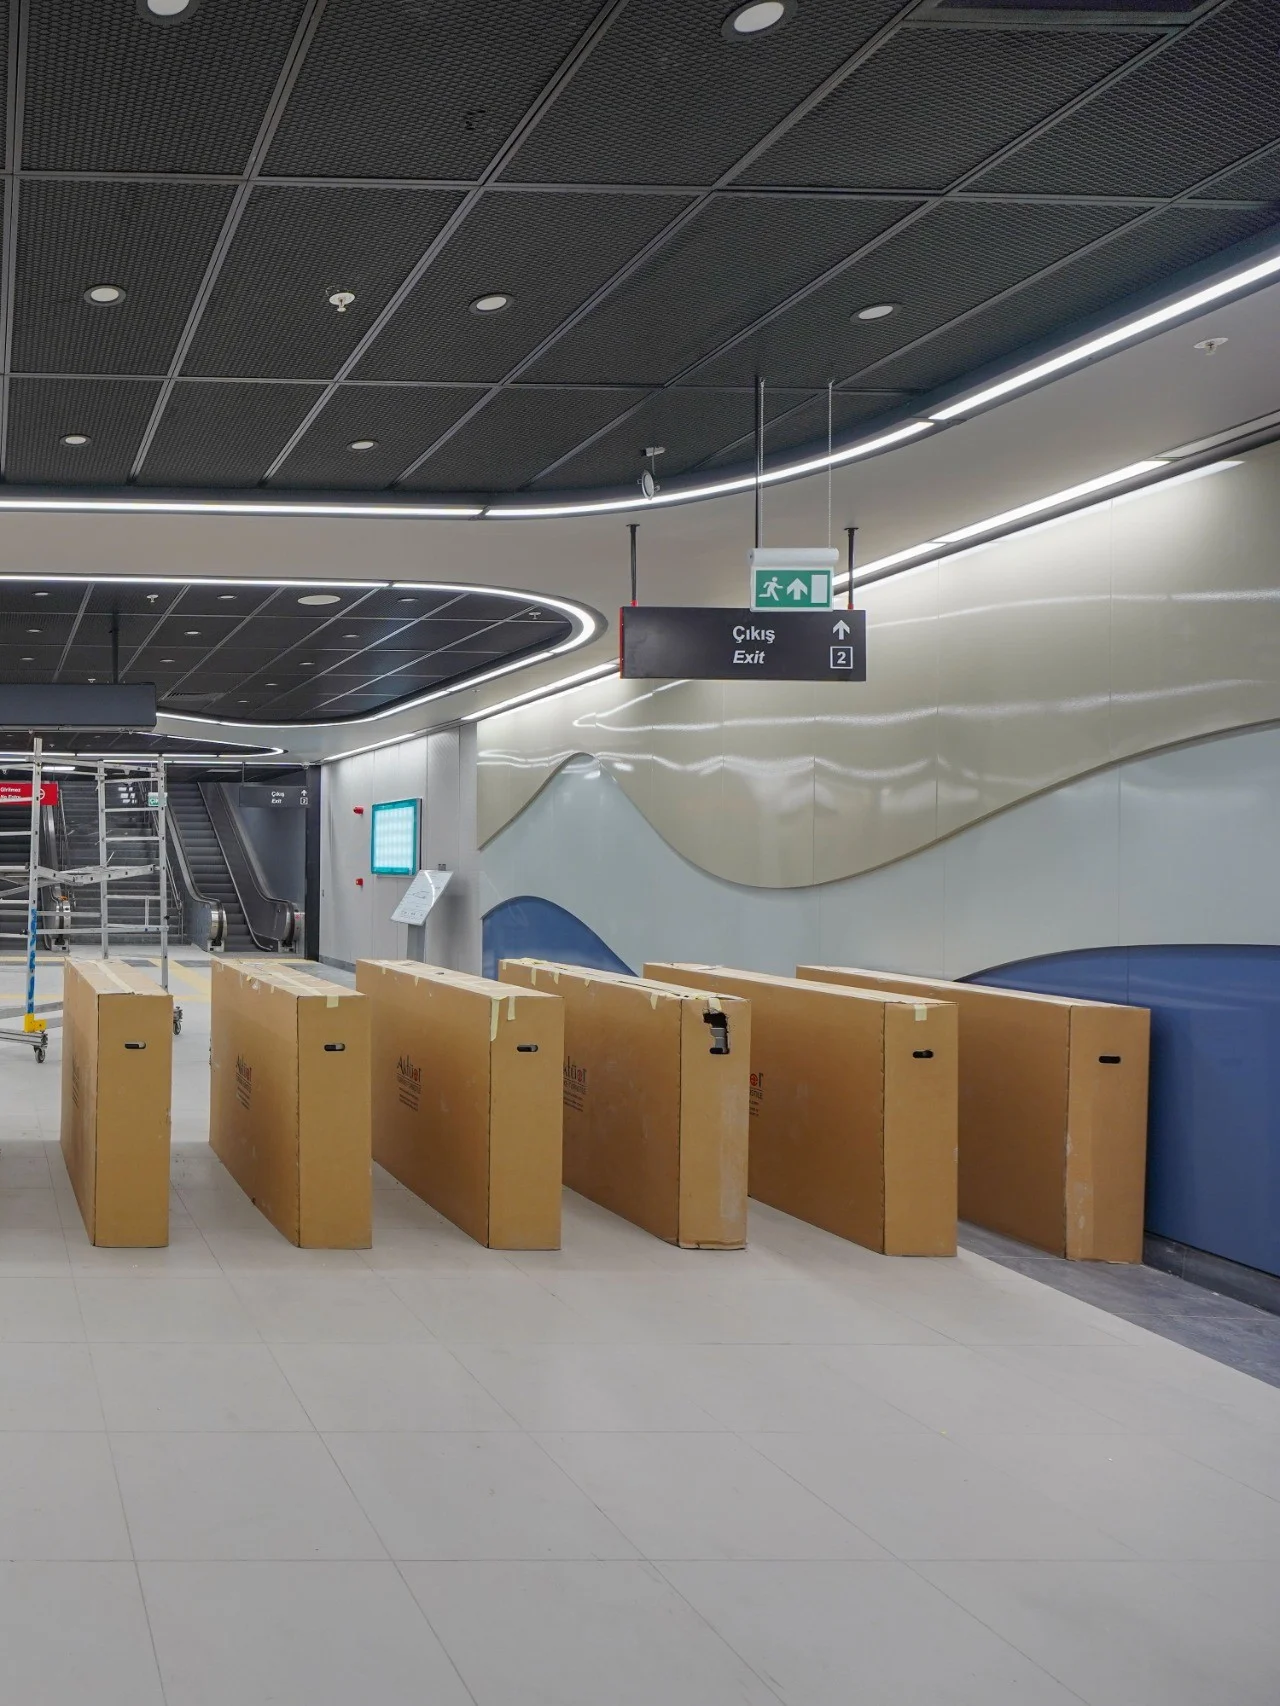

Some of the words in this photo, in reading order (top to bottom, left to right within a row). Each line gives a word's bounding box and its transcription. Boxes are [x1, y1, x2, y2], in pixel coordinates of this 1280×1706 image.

[732, 625, 776, 644] Çıkış
[732, 650, 765, 665] Exit
[836, 651, 846, 664] 2
